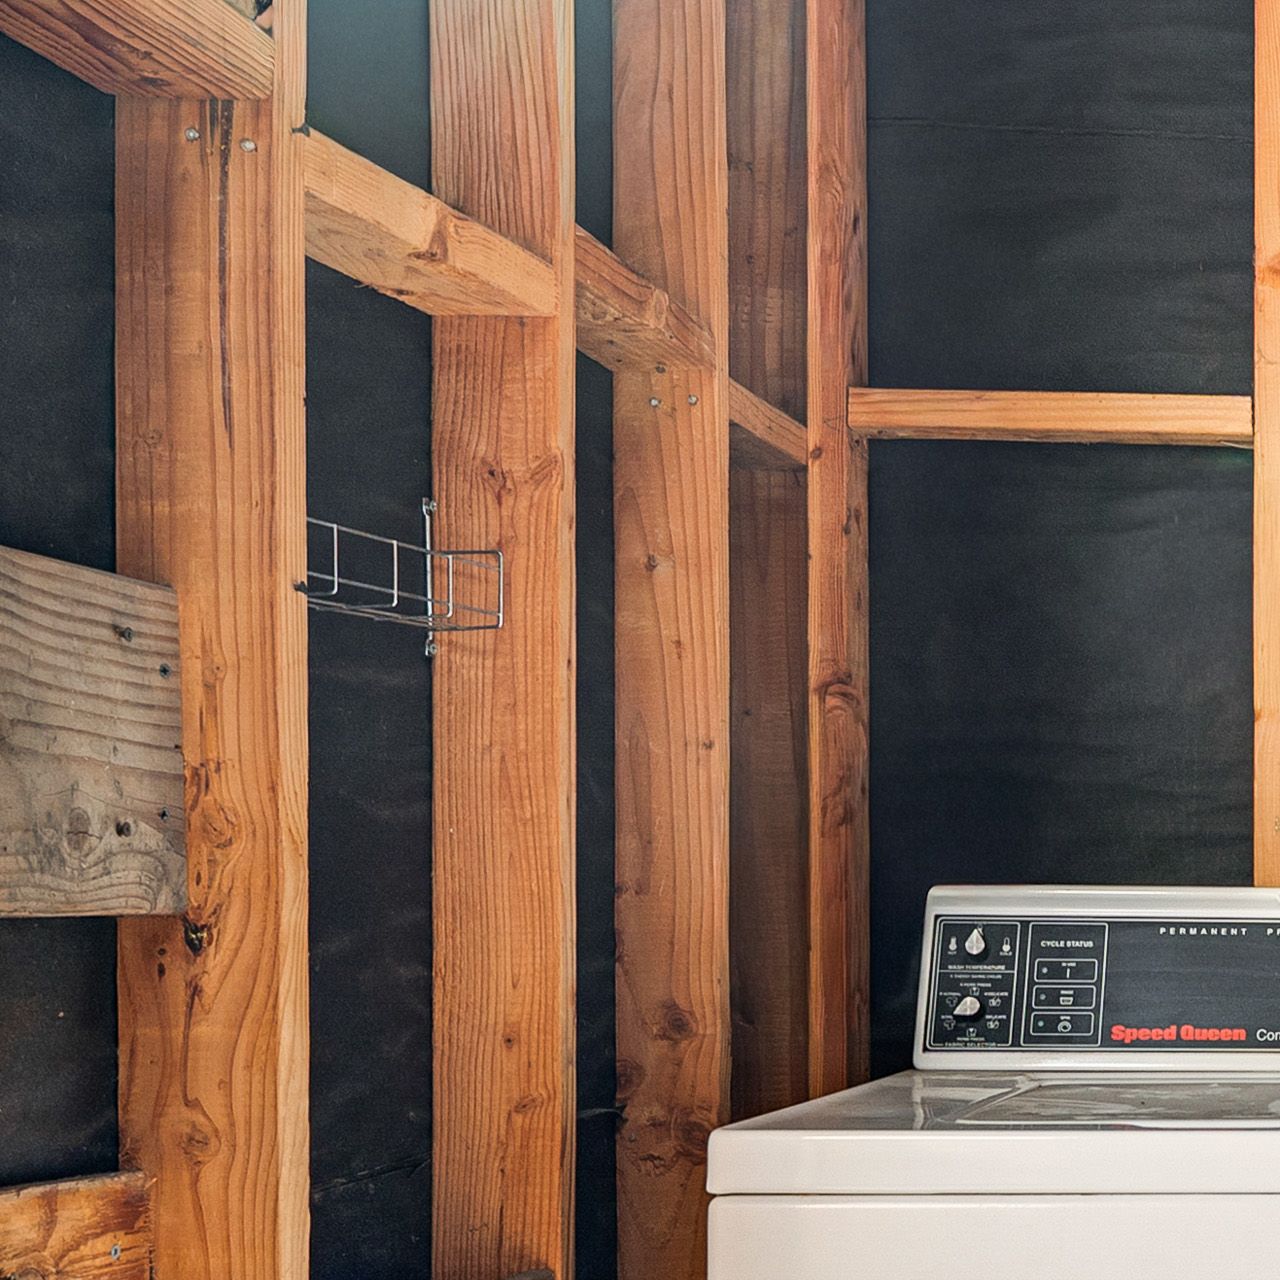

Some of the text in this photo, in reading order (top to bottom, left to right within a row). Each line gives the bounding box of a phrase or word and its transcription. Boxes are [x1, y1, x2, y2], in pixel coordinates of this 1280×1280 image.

[1159, 927, 1248, 936] PERMANENT
[1040, 940, 1094, 948] CYCLE STATUS
[1110, 1025, 1177, 1044] Speed
[1180, 1025, 1247, 1041] Queen
